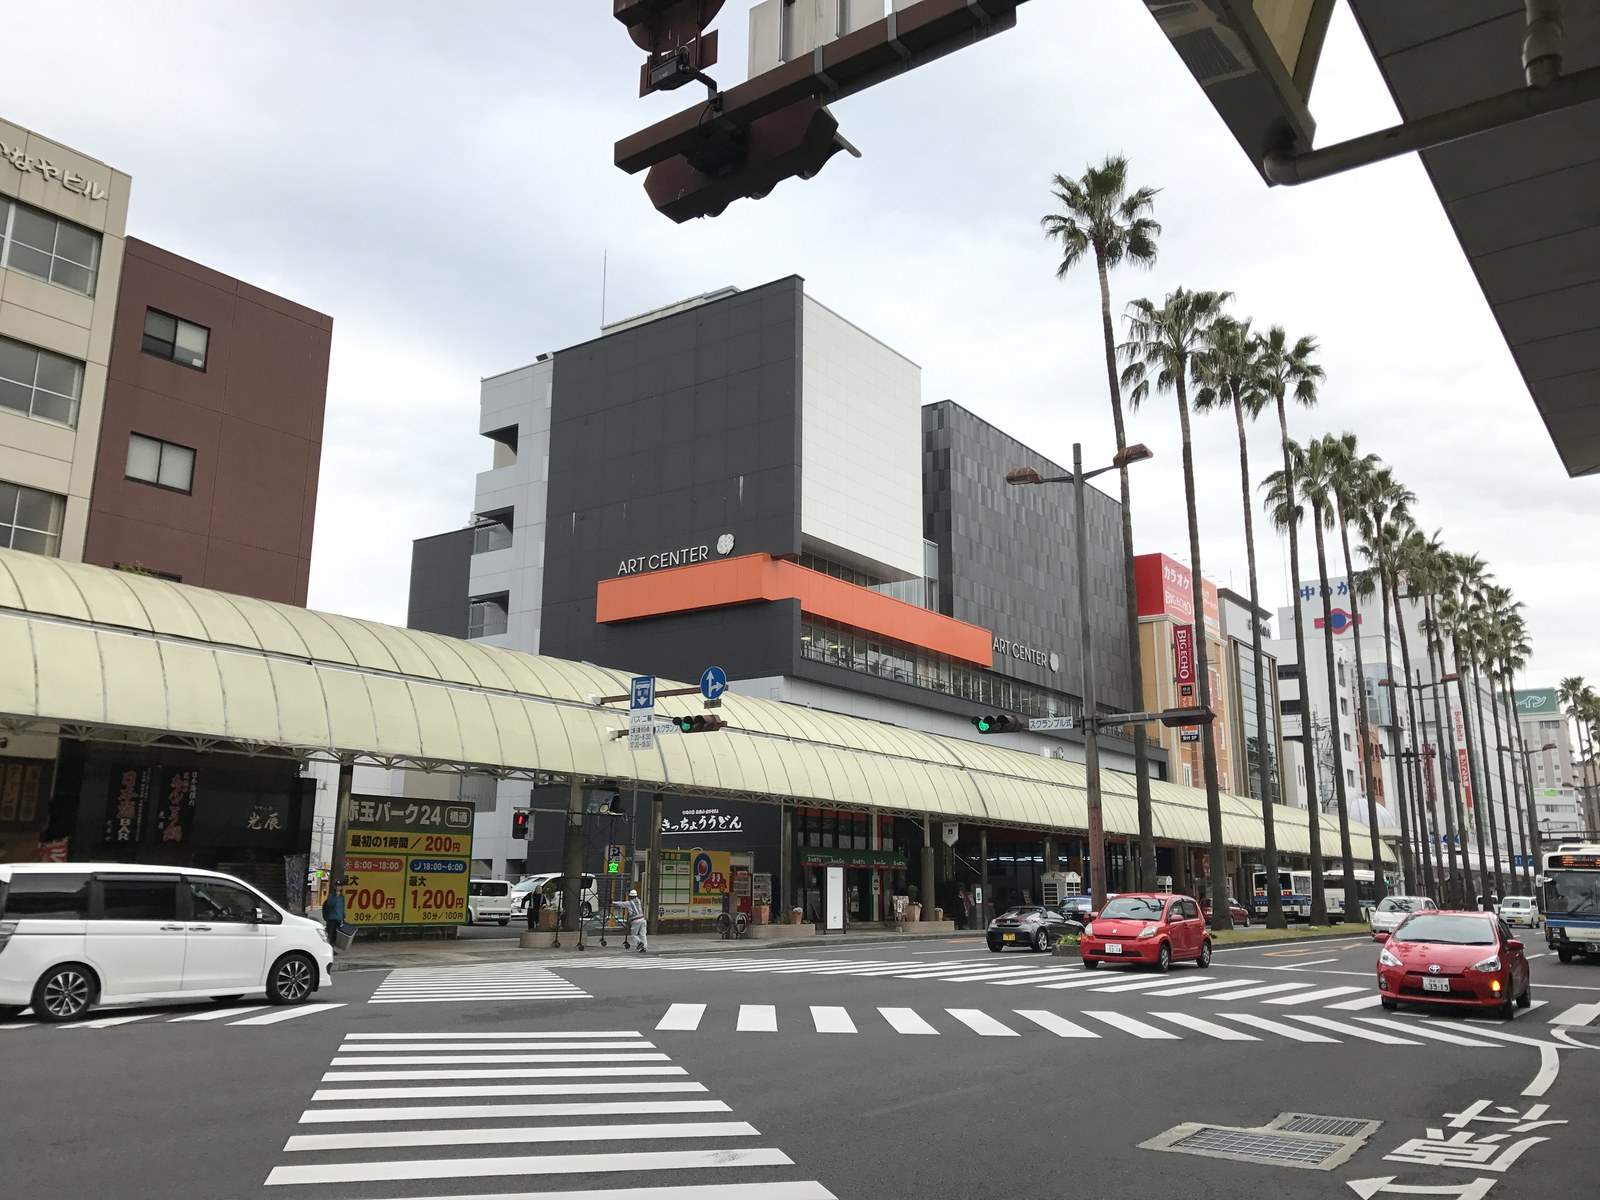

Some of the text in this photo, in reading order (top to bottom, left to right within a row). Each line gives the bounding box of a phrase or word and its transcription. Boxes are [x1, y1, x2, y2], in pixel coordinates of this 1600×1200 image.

[617, 544, 709, 576] ART CENTER
[1163, 564, 1190, 590] カラオケ
[1177, 629, 1187, 650] BIG
[992, 635, 1048, 669] ART CENTER
[1179, 651, 1190, 680] ECHO
[631, 715, 641, 725] バス
[1029, 718, 1073, 730] スクランブル式
[661, 815, 742, 832] きっちょううどん
[608, 862, 619, 873] 空
[408, 875, 427, 887] 最大
[345, 888, 396, 910] 700円
[411, 889, 464, 912] 1,200円
